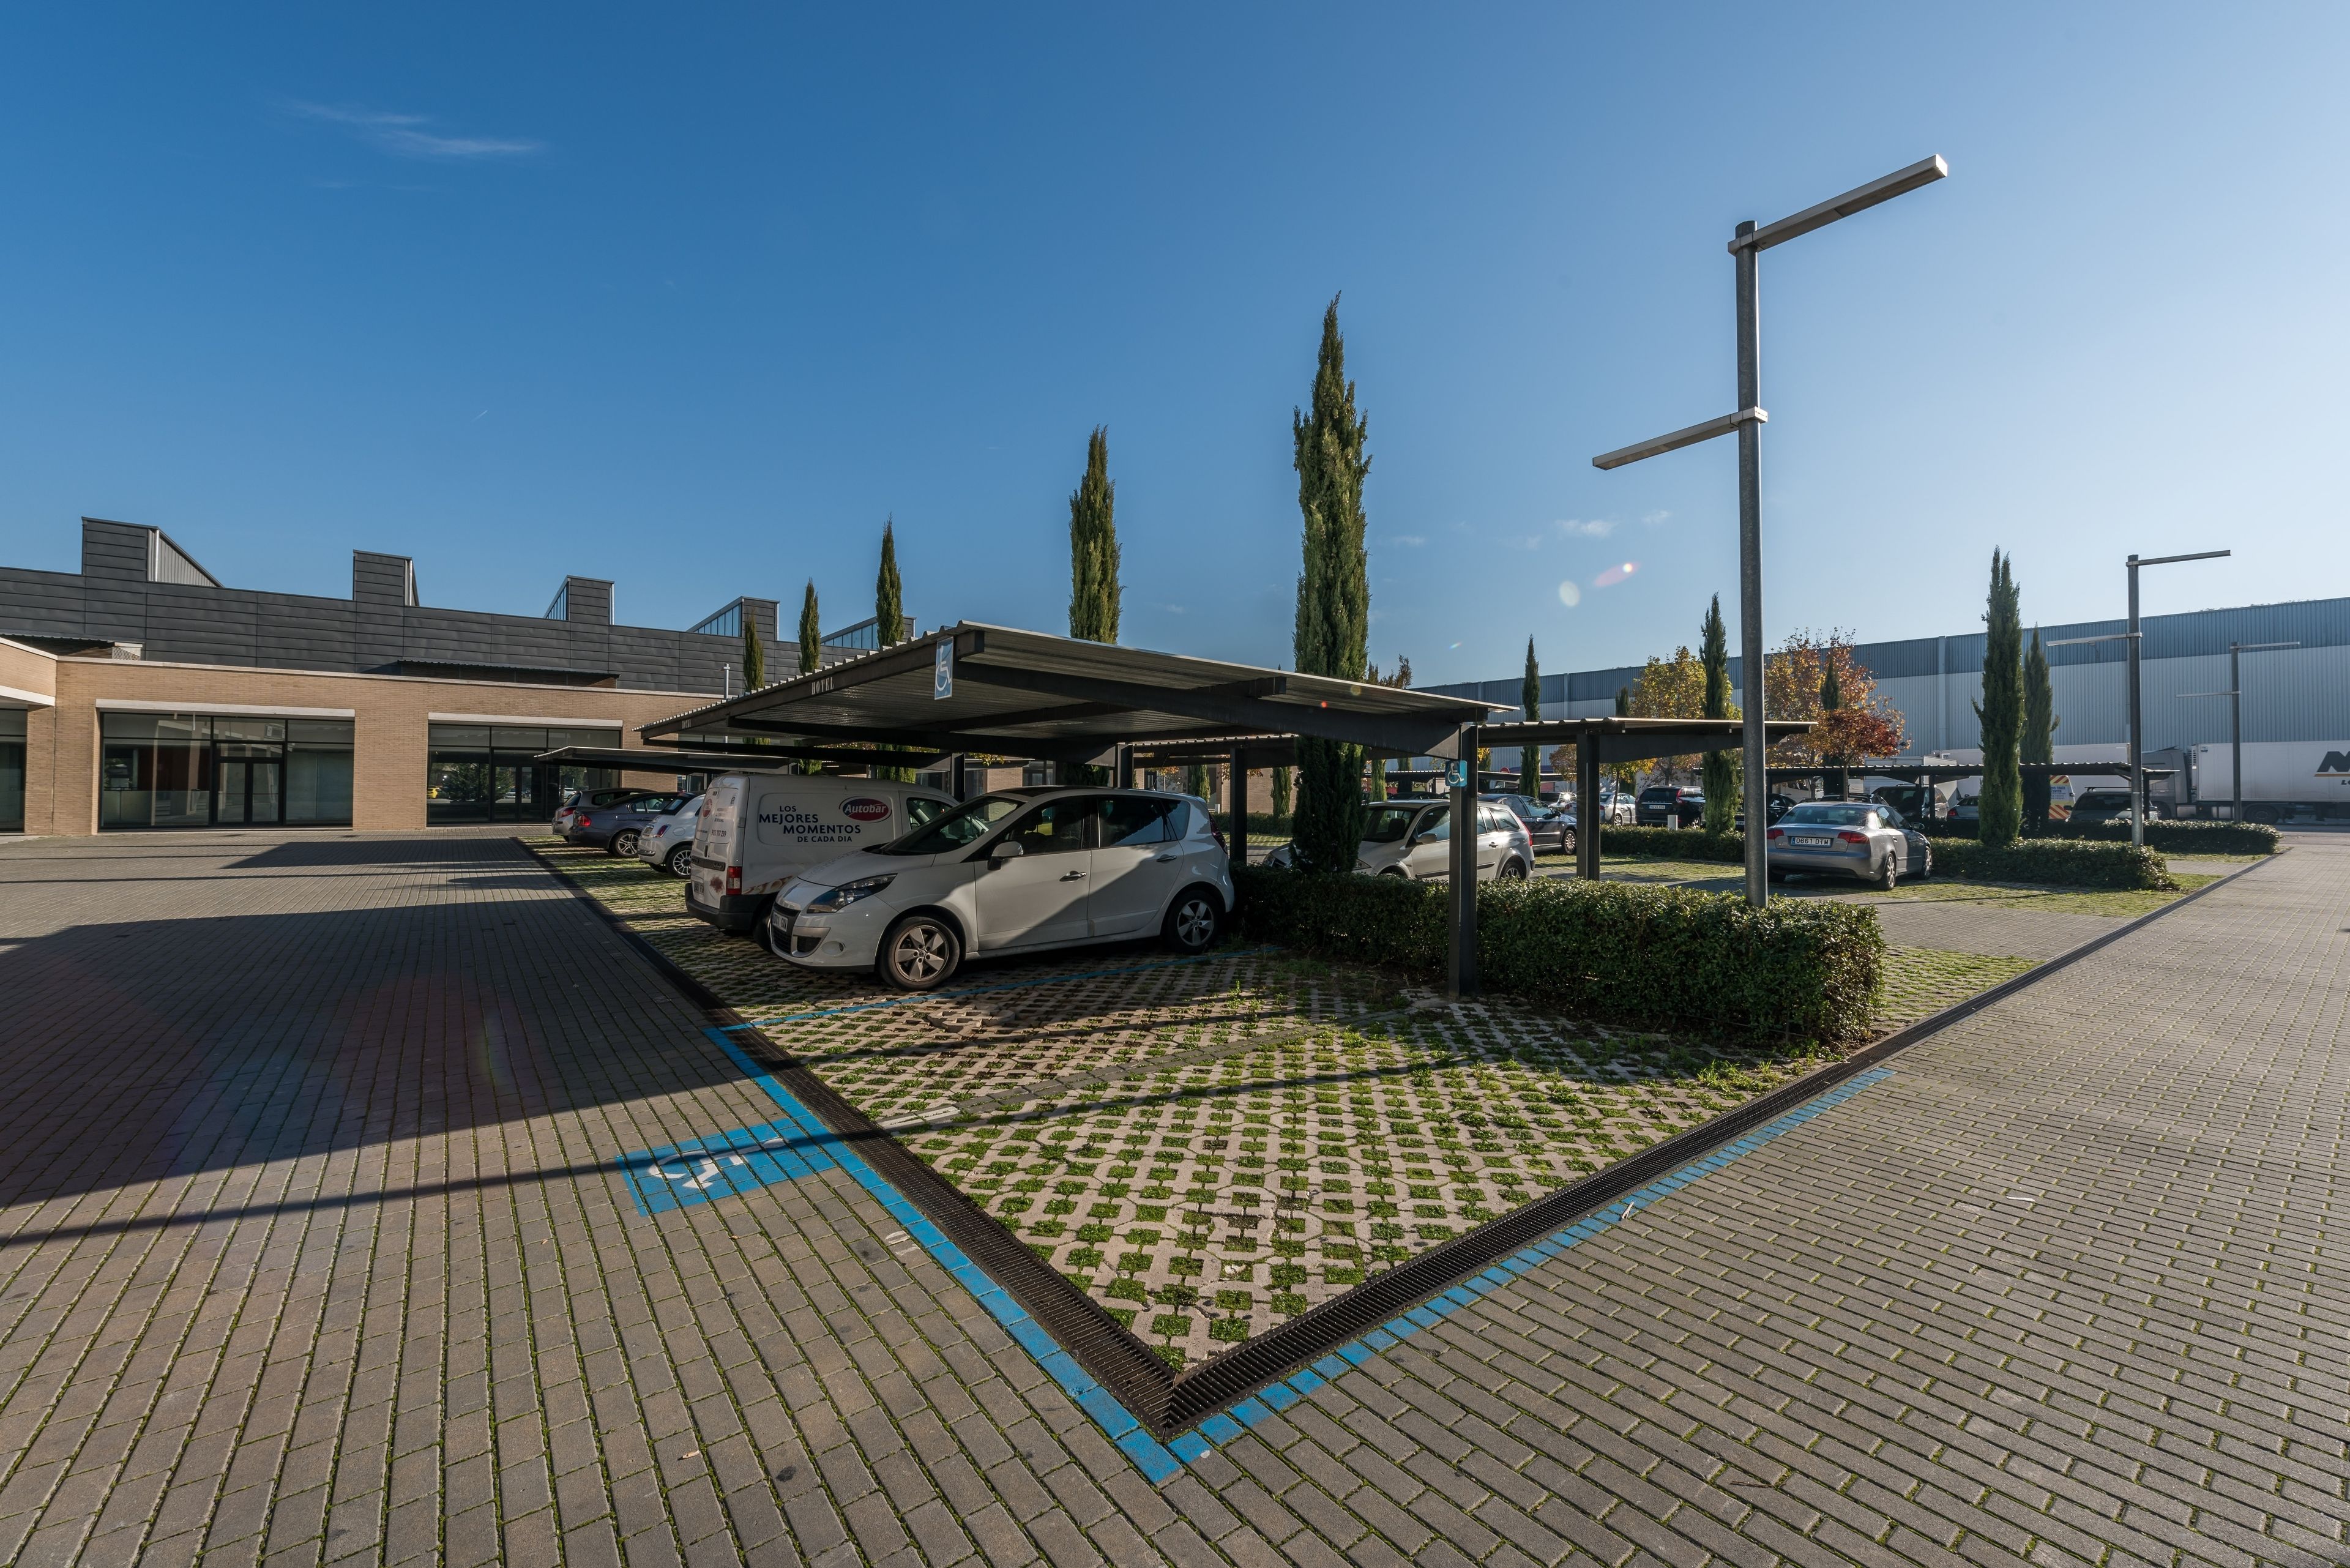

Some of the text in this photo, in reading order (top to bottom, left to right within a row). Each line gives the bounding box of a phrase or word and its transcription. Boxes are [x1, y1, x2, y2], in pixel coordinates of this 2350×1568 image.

[844, 804, 887, 813] Autobar
[758, 813, 819, 825] MEJORES
[783, 824, 861, 834] MOMENTOS
